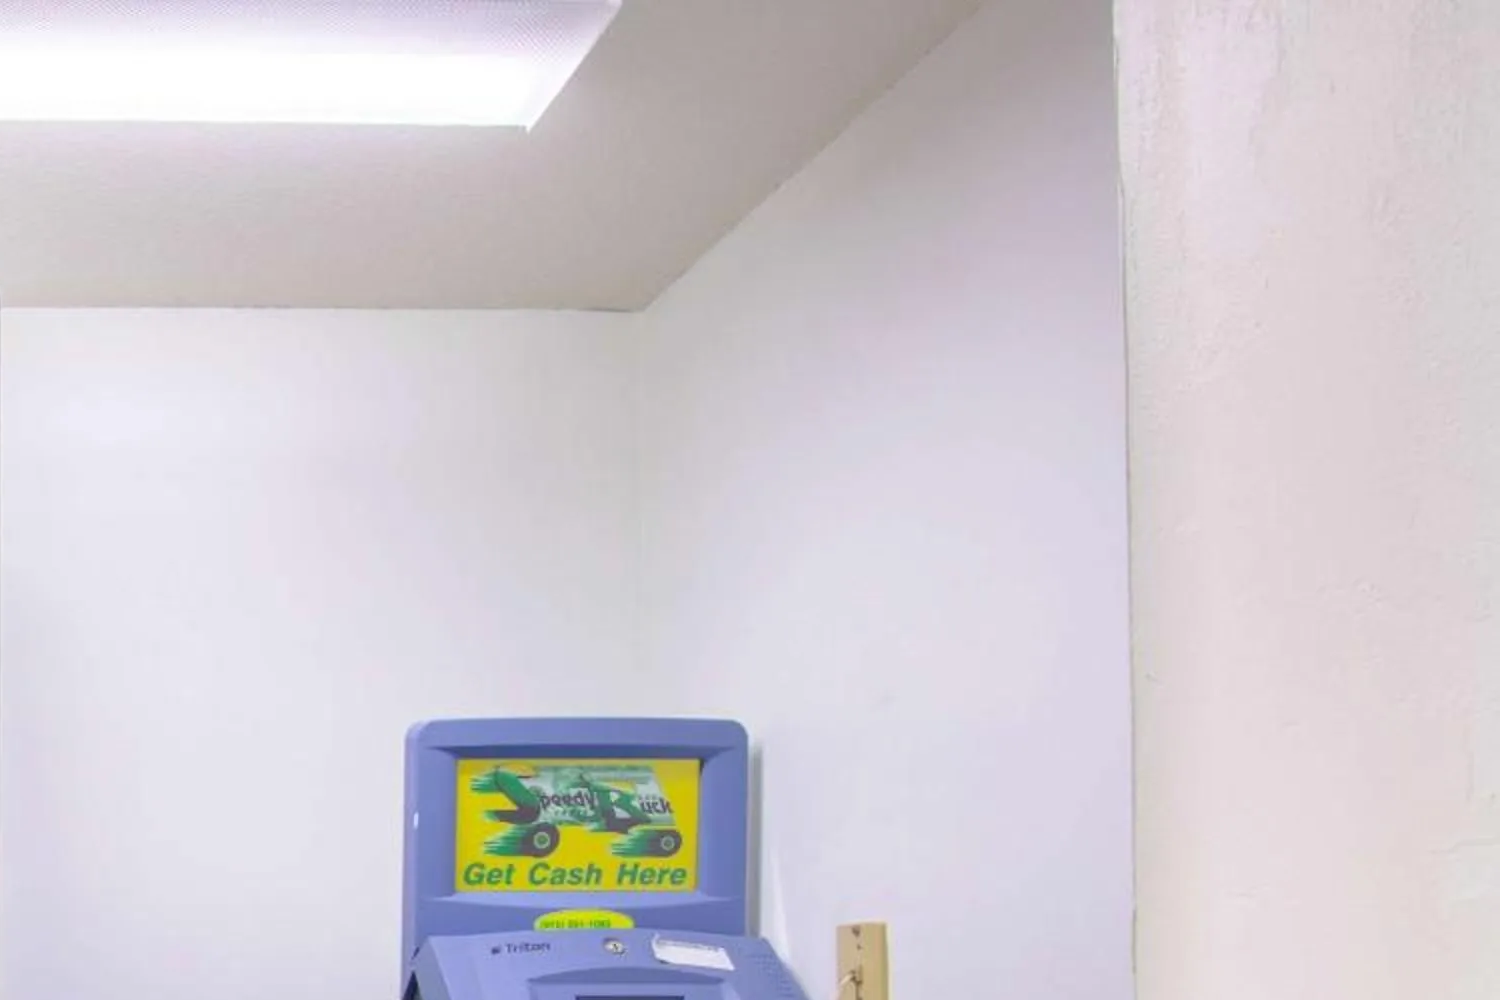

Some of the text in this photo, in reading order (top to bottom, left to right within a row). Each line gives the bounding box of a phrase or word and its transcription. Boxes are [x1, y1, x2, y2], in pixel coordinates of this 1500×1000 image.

[463, 862, 687, 886] Get Cash Here
[504, 941, 551, 955] Triton
